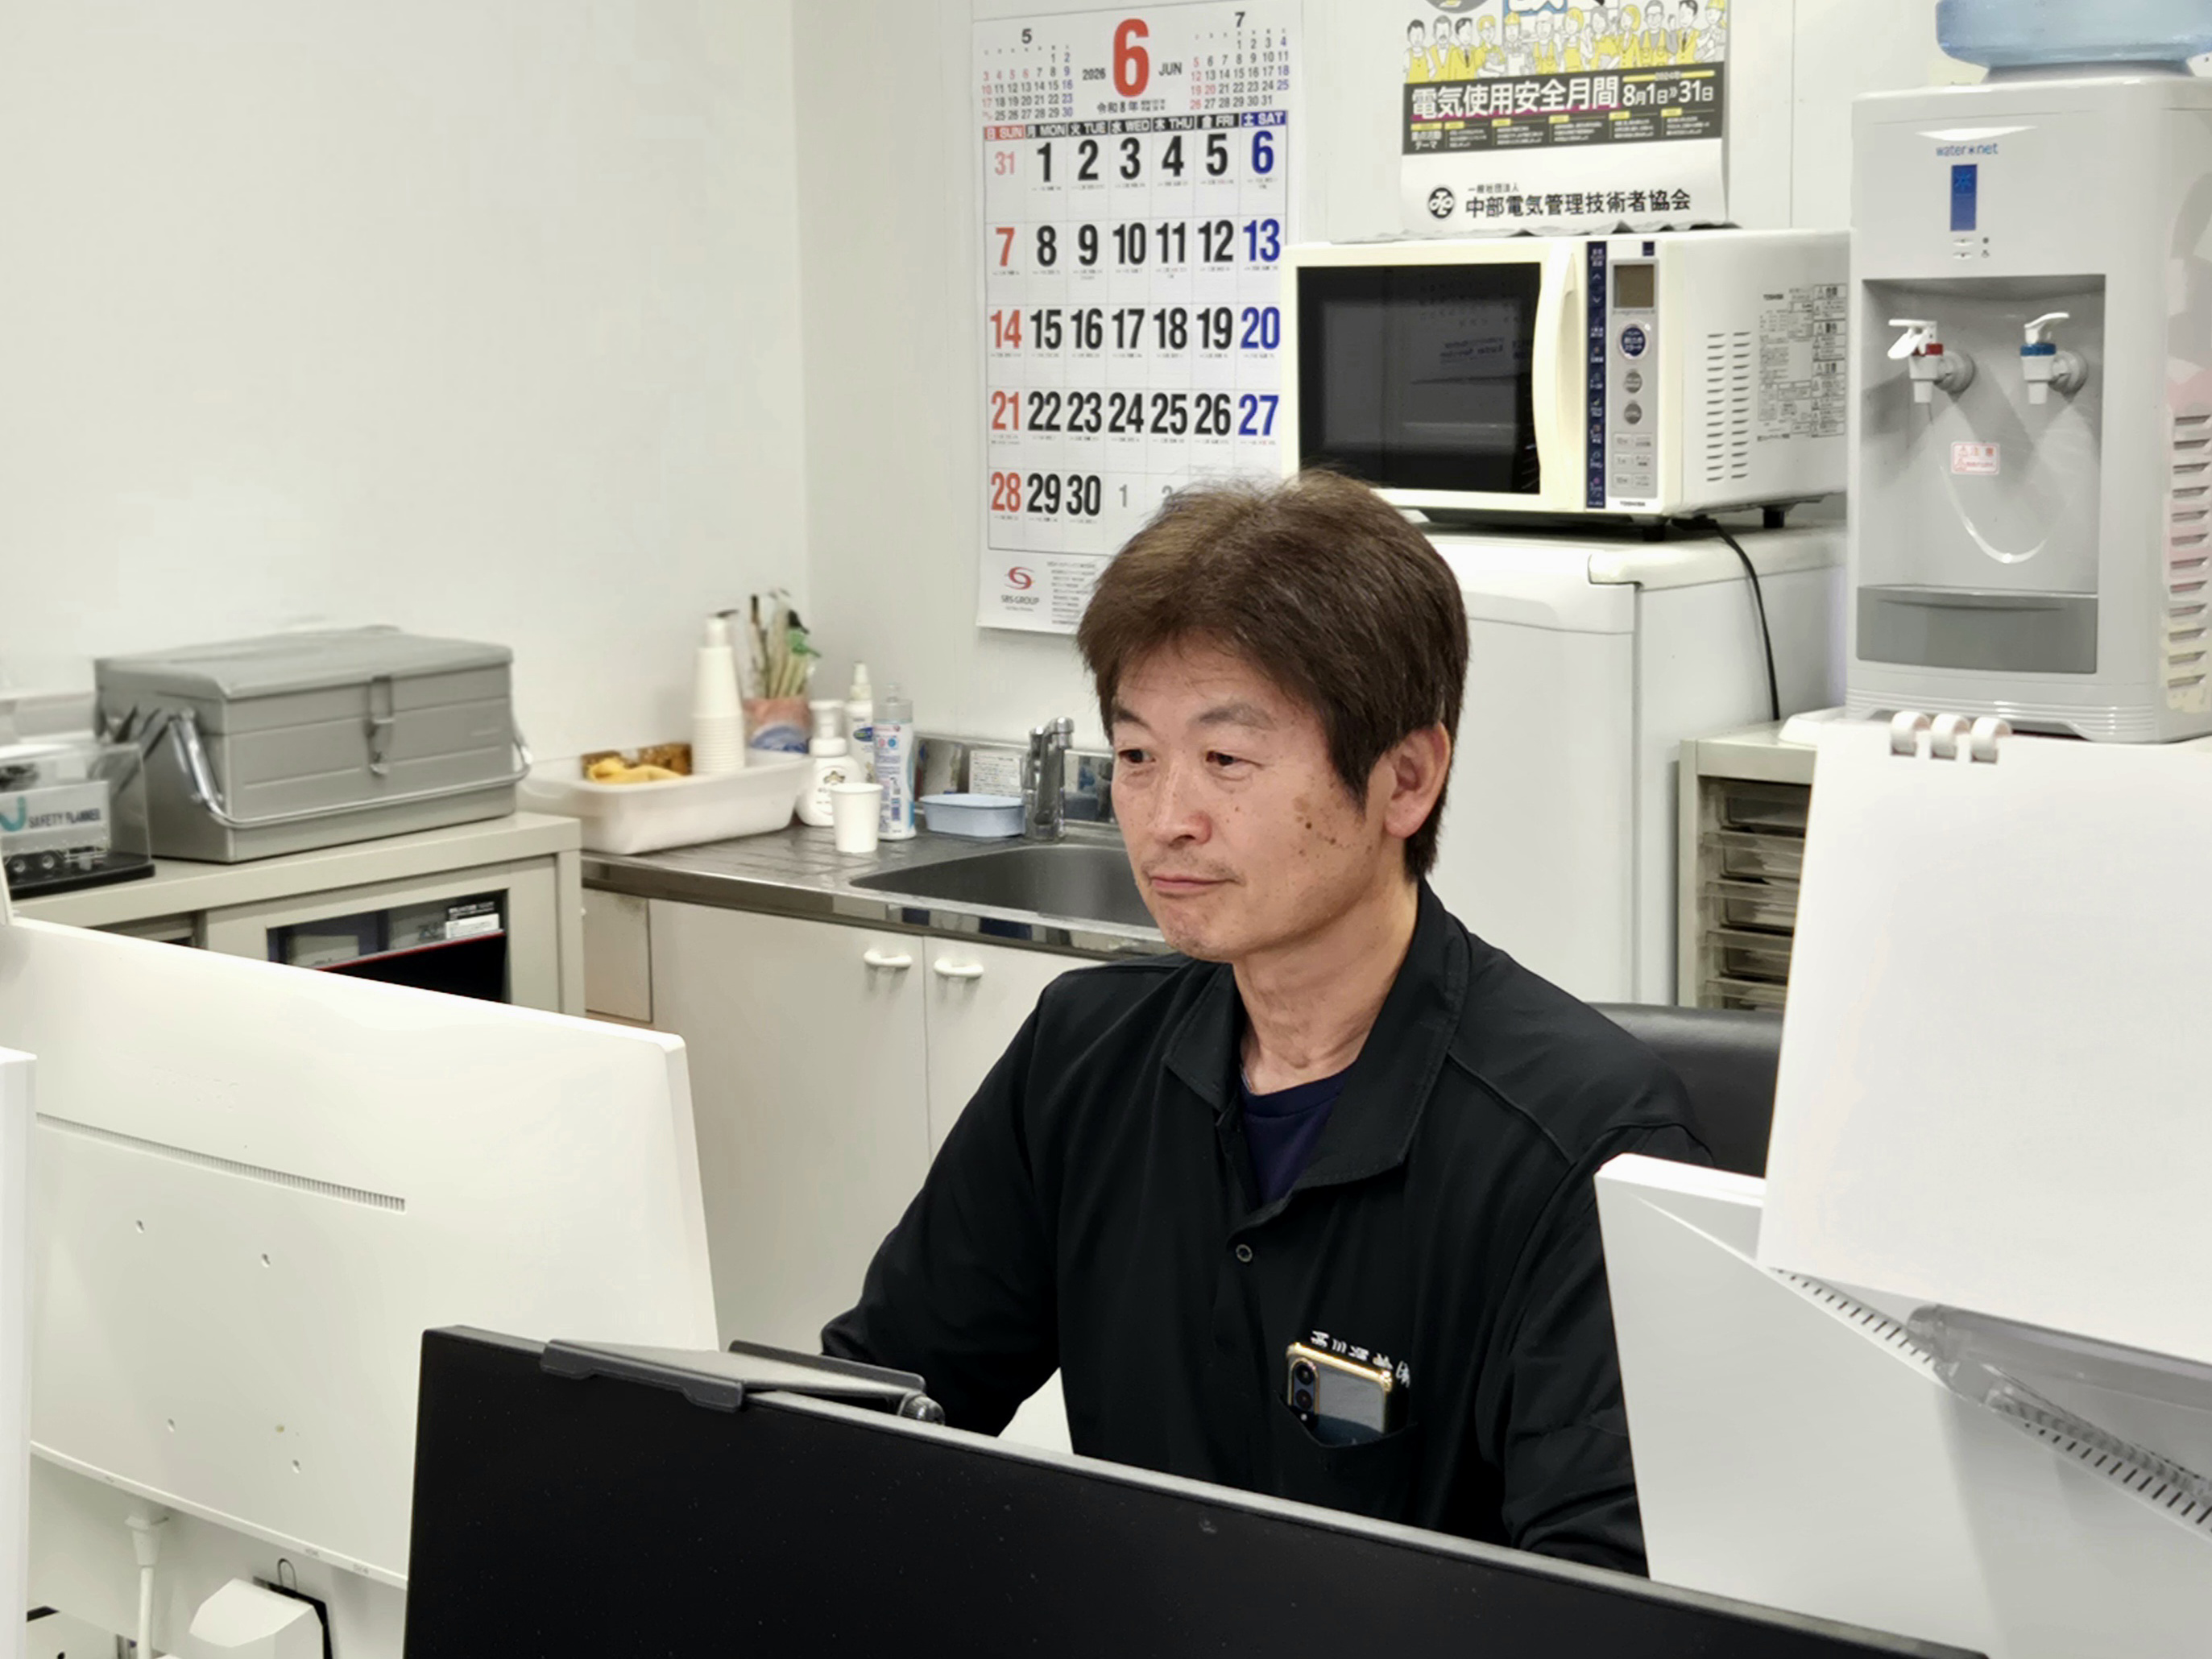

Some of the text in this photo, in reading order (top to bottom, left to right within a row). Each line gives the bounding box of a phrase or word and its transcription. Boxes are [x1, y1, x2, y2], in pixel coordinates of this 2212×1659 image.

[1235, 11, 1245, 27] 7
[1021, 28, 1032, 43] 5
[1113, 18, 1149, 98] 6
[1082, 68, 1106, 81] 2026
[1158, 62, 1183, 77] JUN
[1412, 76, 1619, 120] 電気使用安全月間
[1125, 119, 1150, 132] WED
[1169, 118, 1192, 130] THU
[1216, 114, 1235, 127] FRI
[1258, 112, 1283, 125] SAT
[999, 126, 1022, 139] SUN
[1039, 124, 1065, 137] MON
[1083, 122, 1105, 134] TUE
[994, 130, 1274, 183] 31 1 2 3 4 5 6
[1468, 182, 1520, 193] 一般社団法人
[1464, 188, 1692, 219] 中部電気管理技術者協会
[996, 217, 1281, 267] 7 8 9 10 11 12 13
[990, 306, 1281, 350] 14 15 16 17 18 19 20
[991, 390, 1280, 436] 21 22 23 24 25 26 27
[991, 471, 1128, 517] 28 29 30 1
[28, 812, 64, 829] SAFETY
